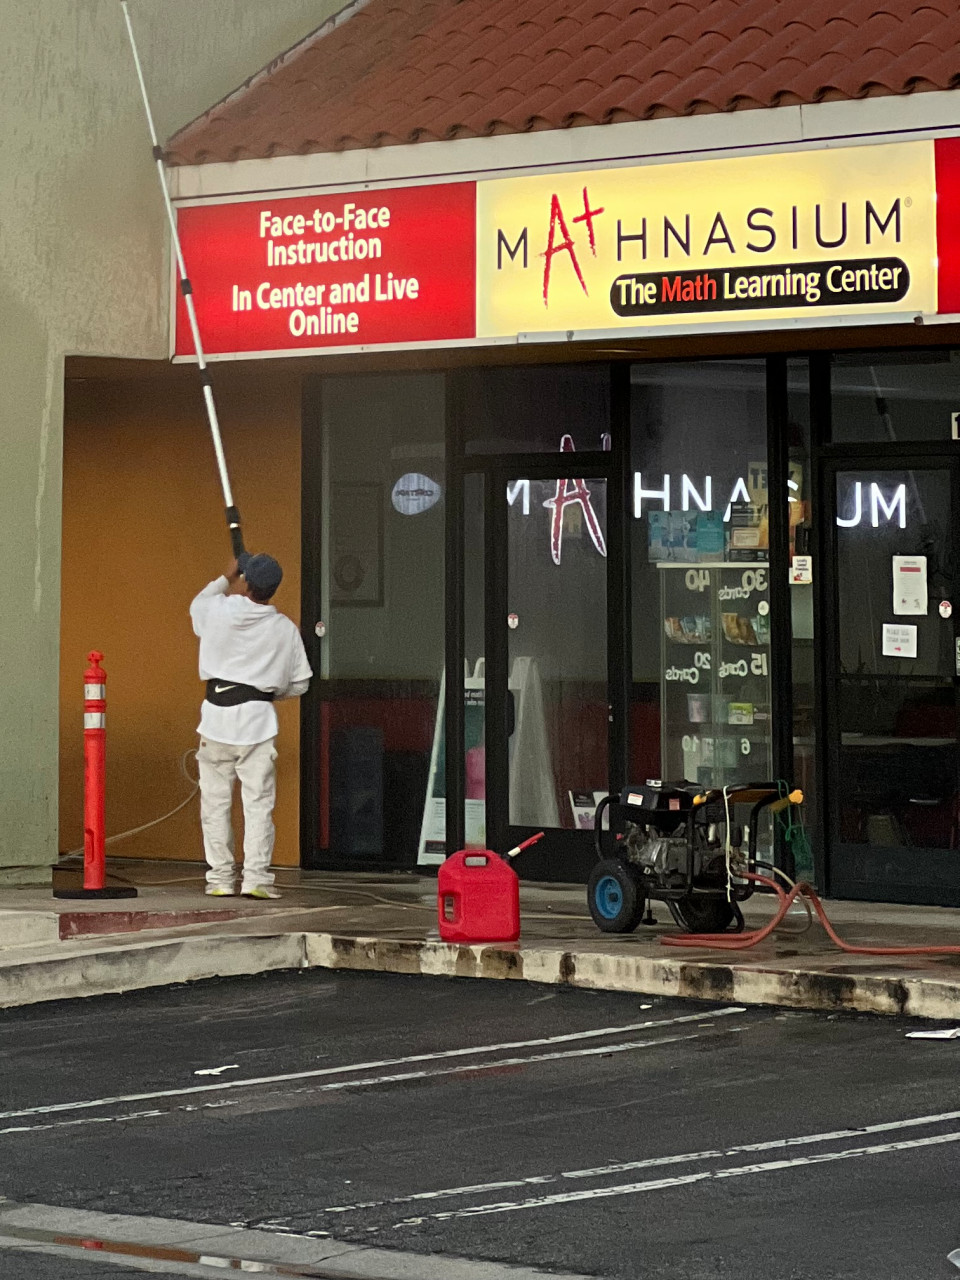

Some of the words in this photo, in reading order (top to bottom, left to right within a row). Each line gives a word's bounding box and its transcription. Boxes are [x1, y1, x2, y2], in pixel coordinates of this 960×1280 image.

[260, 203, 390, 237] Face-to-Face
[267, 232, 381, 266] Instruction
[232, 285, 252, 311] In
[256, 282, 325, 309] Center
[329, 273, 369, 304] and
[375, 272, 419, 301] Live
[615, 278, 657, 305] The
[661, 273, 716, 303] Math
[723, 268, 821, 300] Learning
[825, 264, 903, 294] Center
[289, 307, 359, 336] Online
